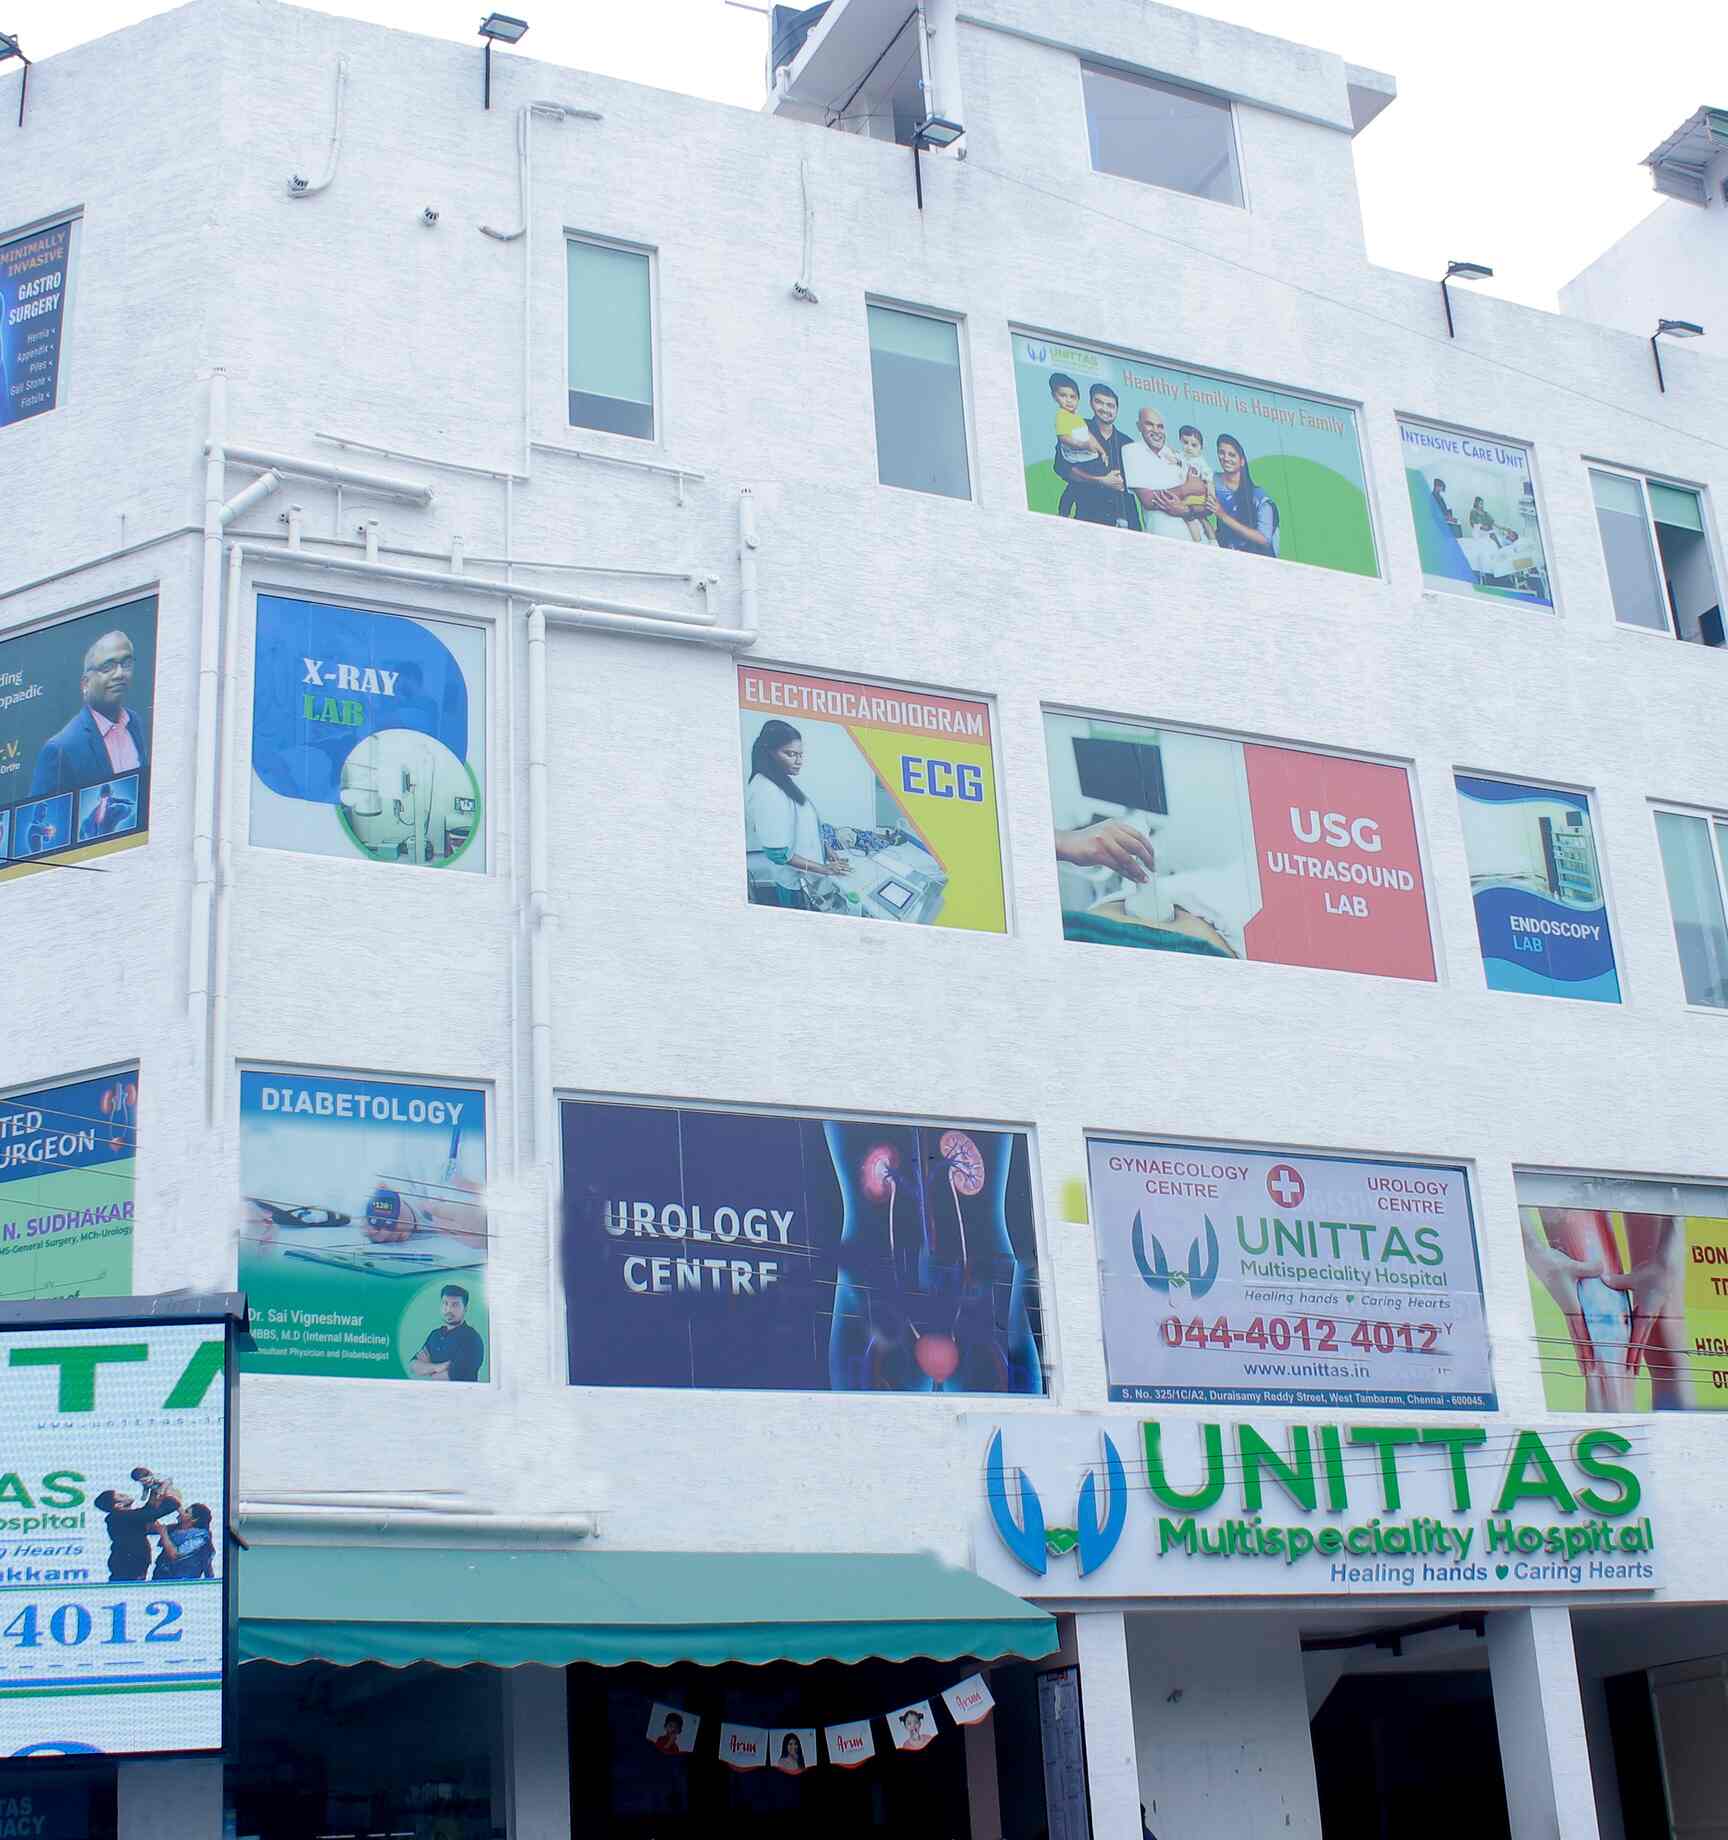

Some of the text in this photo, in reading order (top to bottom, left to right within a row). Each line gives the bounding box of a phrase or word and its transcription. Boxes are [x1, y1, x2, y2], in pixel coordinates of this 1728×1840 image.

[7, 247, 64, 277] INVASIVE
[18, 271, 62, 301] GASTRO
[8, 293, 60, 325] SURGERY
[1122, 369, 1345, 436] Healthy Family is Happy Family
[303, 657, 399, 697] X-RAY
[303, 694, 366, 726] LAB
[744, 677, 985, 737] ELECTROCARDIOGRAM
[900, 755, 984, 803] ECG
[1289, 806, 1382, 853] USG
[1267, 850, 1415, 892] ULTRASOUND
[1324, 893, 1369, 918] LAB
[1510, 915, 1600, 942] ENDOSCOPY
[1512, 935, 1543, 952] LAB
[261, 1086, 464, 1125] DIABETOLOGY
[1108, 1156, 1249, 1181] GYNAECOLOGY
[1145, 1180, 1219, 1199] CENTRE
[1367, 1176, 1449, 1196] UROLOGY
[3, 1200, 135, 1241] N. SUDHAKAR
[1377, 1197, 1445, 1214] CENTRE
[605, 1200, 794, 1245] UROLOGY
[1236, 1215, 1444, 1266] UNITTAS
[1241, 1260, 1448, 1287] Multispeciality Hospital
[1244, 1289, 1451, 1310] Healing hands Caring Hearts
[248, 1308, 364, 1327] Dr. Sai Vigneshwar
[303, 1332, 342, 1344] (Internal
[344, 1334, 390, 1346] Medicine)
[1162, 1315, 1438, 1354] 044-4012 4012
[1243, 1363, 1370, 1378] www.unittas.in
[1210, 1390, 1261, 1404] Duraisamy
[1263, 1392, 1294, 1404] Reddy
[1297, 1392, 1327, 1403] Street,
[1329, 1392, 1352, 1403] West
[1355, 1393, 1404, 1405] Tambaram,
[1407, 1394, 1444, 1405] Chennai
[1139, 1420, 1643, 1517] UNITTAS
[0, 1471, 86, 1509] AS
[13, 1544, 83, 1557] Hearts
[1154, 1515, 1653, 1566] Multispeciality Hospital
[1330, 1561, 1653, 1585] Healing hands Caring Hearts
[3, 1600, 184, 1648] 4012
